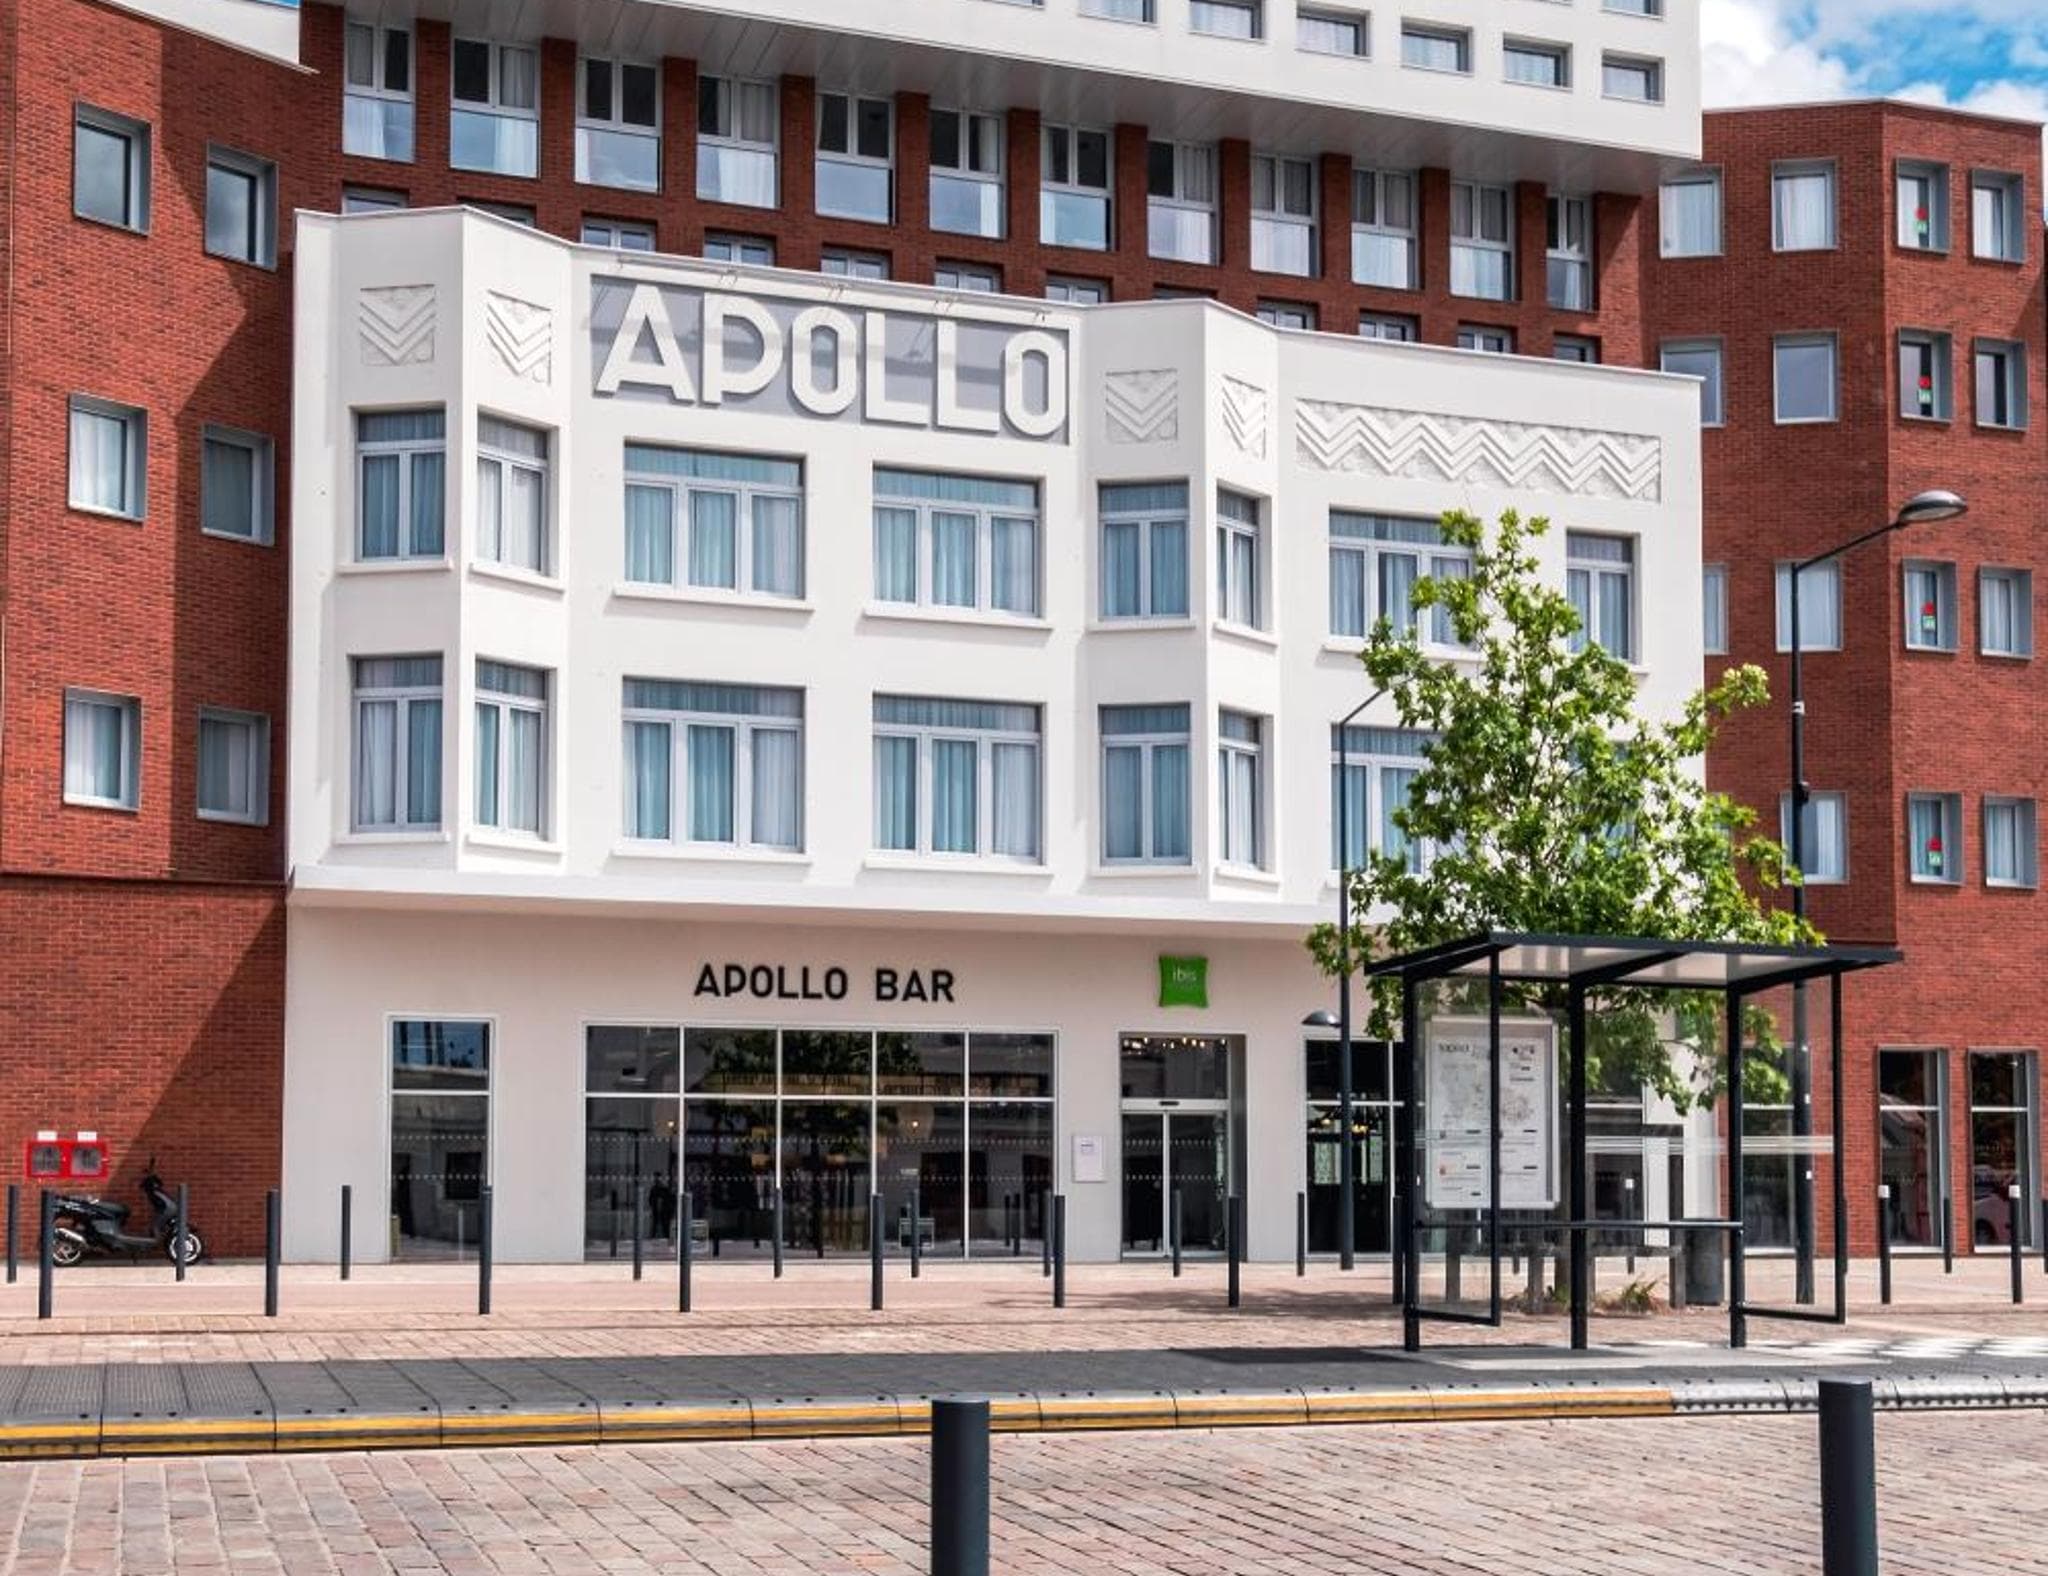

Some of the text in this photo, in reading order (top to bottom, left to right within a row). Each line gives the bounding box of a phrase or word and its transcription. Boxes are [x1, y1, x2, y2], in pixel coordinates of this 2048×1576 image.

[595, 284, 1067, 438] APOLLO
[693, 963, 955, 1003] APOLLO BAR
